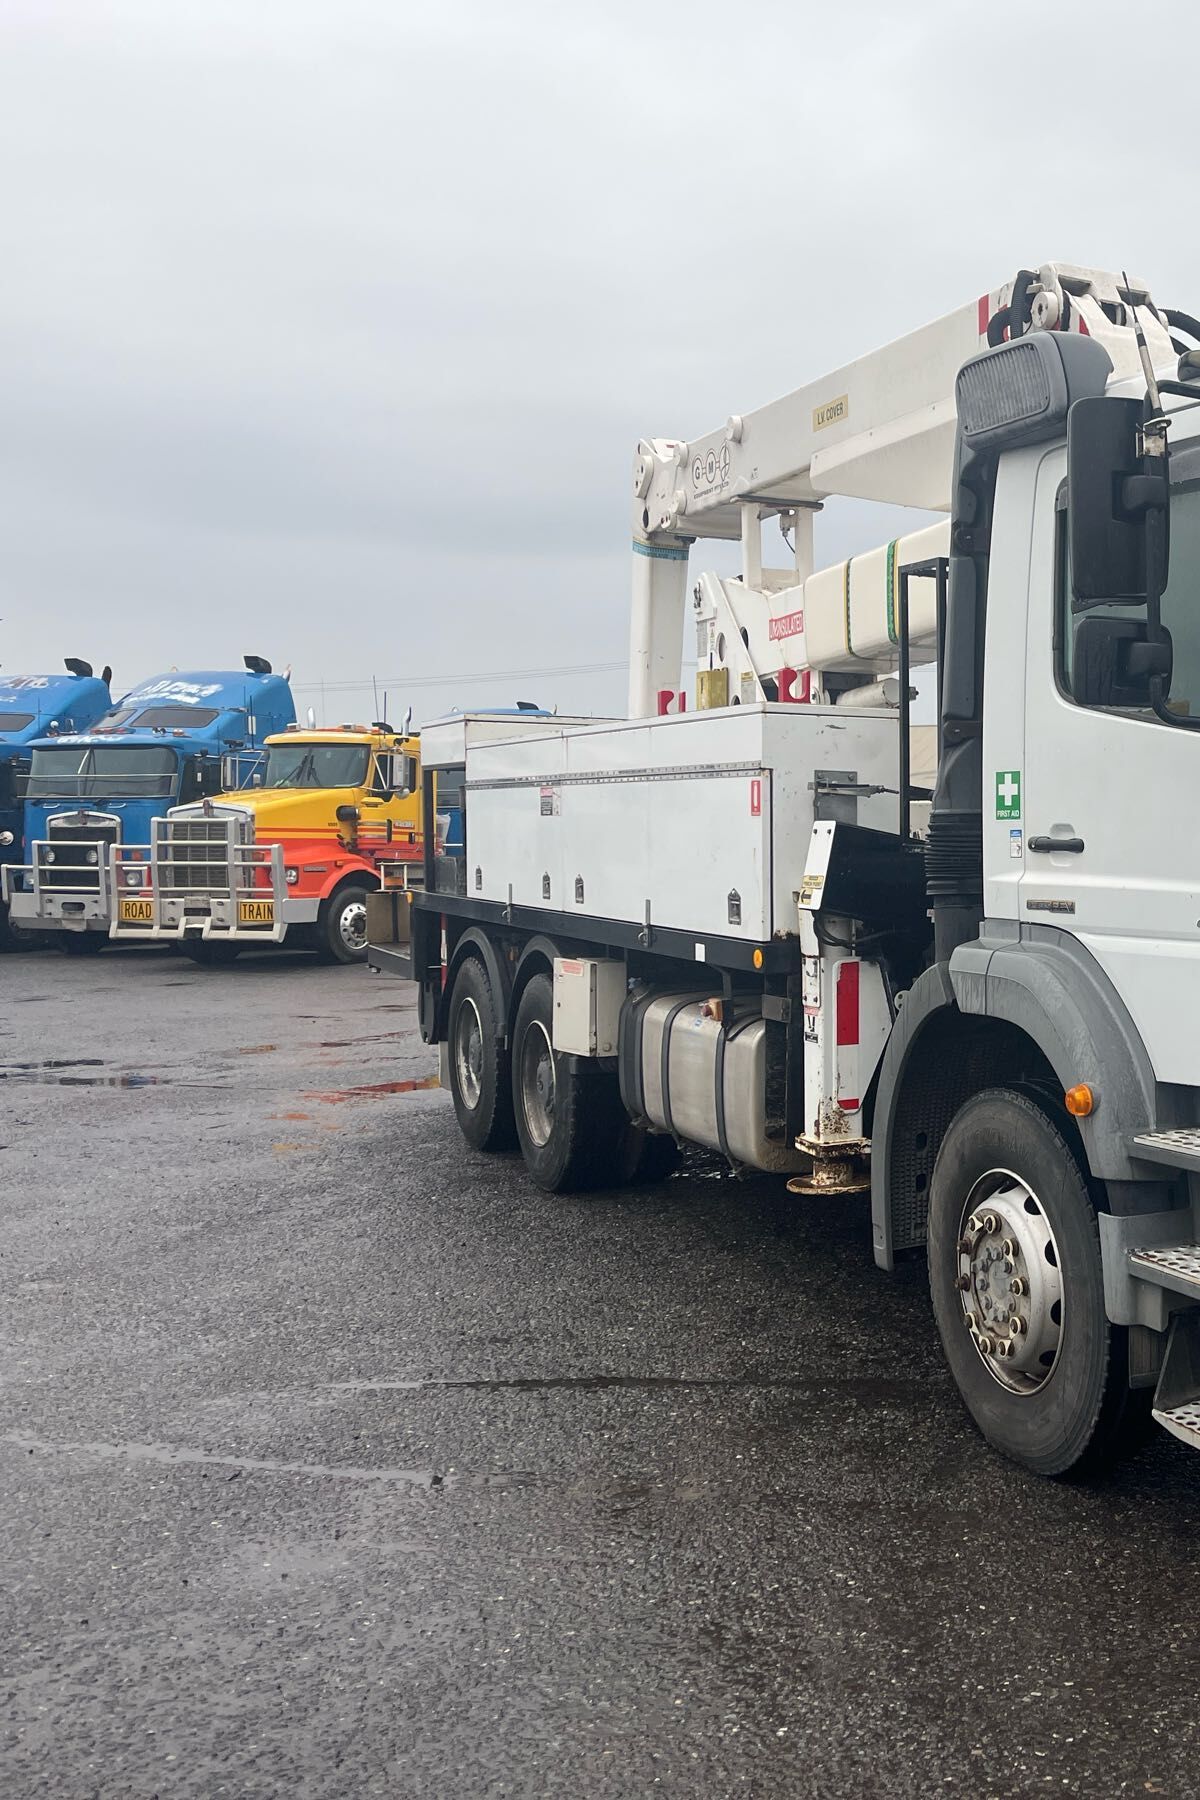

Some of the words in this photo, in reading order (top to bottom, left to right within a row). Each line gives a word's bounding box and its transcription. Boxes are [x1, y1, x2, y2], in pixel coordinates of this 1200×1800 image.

[826, 401, 844, 421] COVER
[996, 809, 1011, 819] FIRST
[1011, 809, 1020, 818] AID
[124, 902, 152, 918] ROAD
[242, 903, 274, 919] TRAIN
